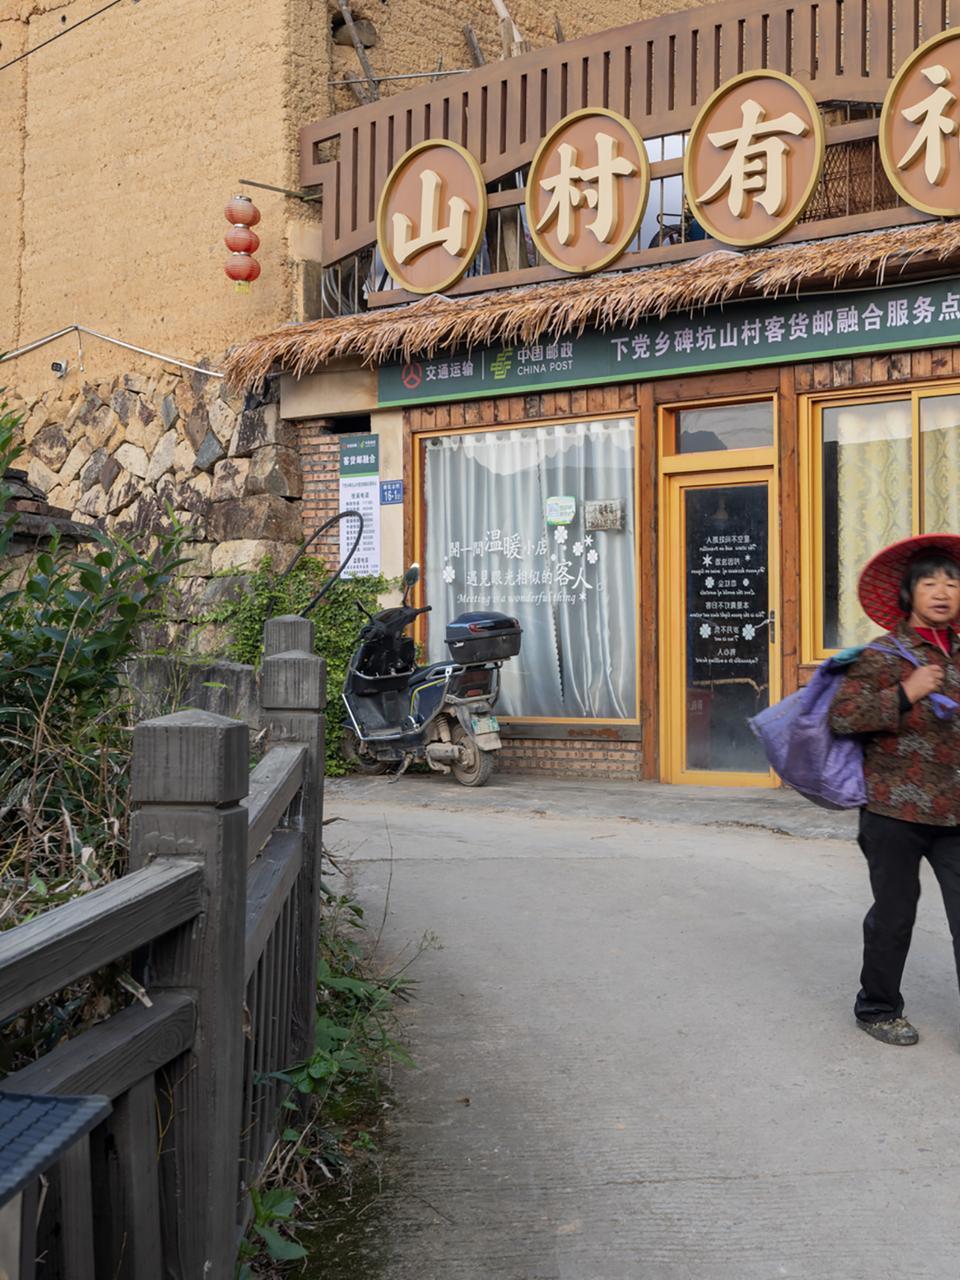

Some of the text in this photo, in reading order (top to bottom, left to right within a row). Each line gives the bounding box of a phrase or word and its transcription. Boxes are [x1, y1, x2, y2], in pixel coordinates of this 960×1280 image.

[517, 341, 574, 363] 中国邮政
[425, 360, 474, 381] 交通运输
[517, 360, 573, 376] CHINA POST
